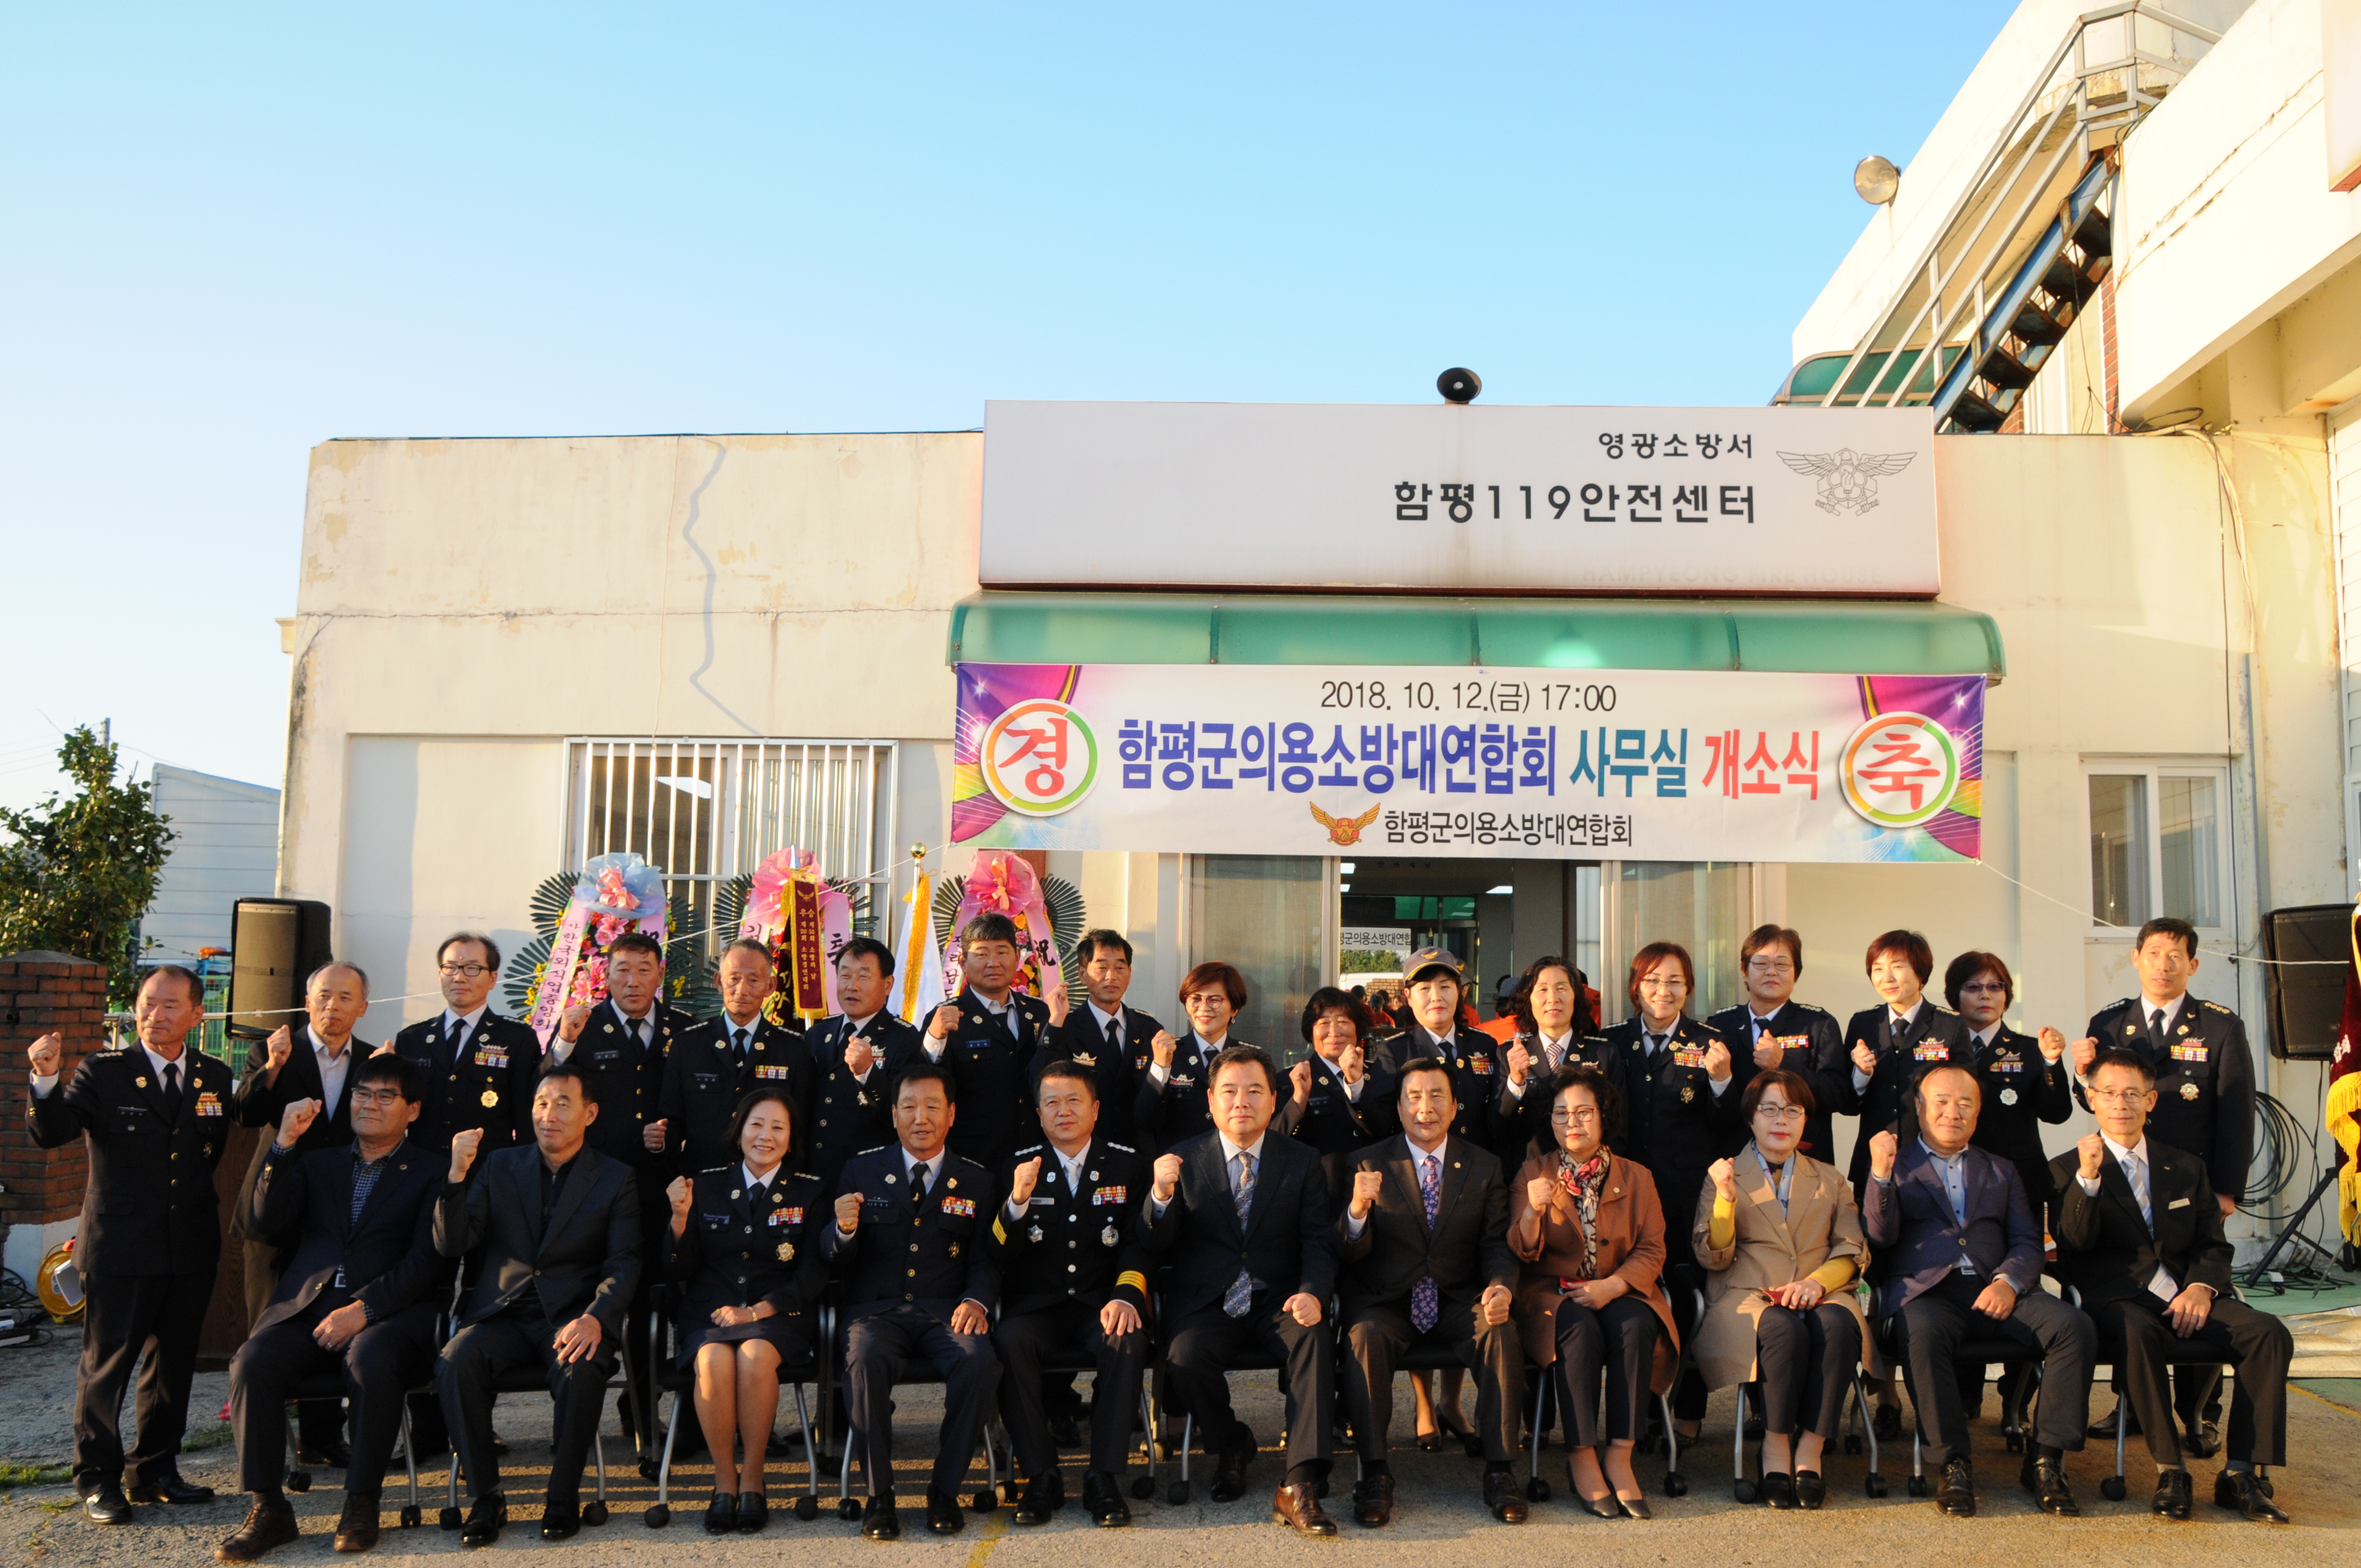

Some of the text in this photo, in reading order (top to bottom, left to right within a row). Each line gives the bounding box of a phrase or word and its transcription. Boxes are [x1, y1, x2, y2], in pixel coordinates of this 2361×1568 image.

[1598, 433, 1752, 460] 영광소방서
[1394, 481, 1754, 524] 함평119안전센터
[1321, 681, 1391, 711] 2018.
[1404, 682, 1439, 711] 10.
[1542, 684, 1617, 712] 17:00
[998, 717, 1068, 797] 경
[1118, 719, 1819, 801] 함평군의용소방대연합회 사무실 개소식
[1857, 733, 1941, 812] 축
[1384, 810, 1633, 848] 함평군의용소방대연합회
[799, 908, 815, 918] 우승
[1033, 939, 1056, 967] 祝
